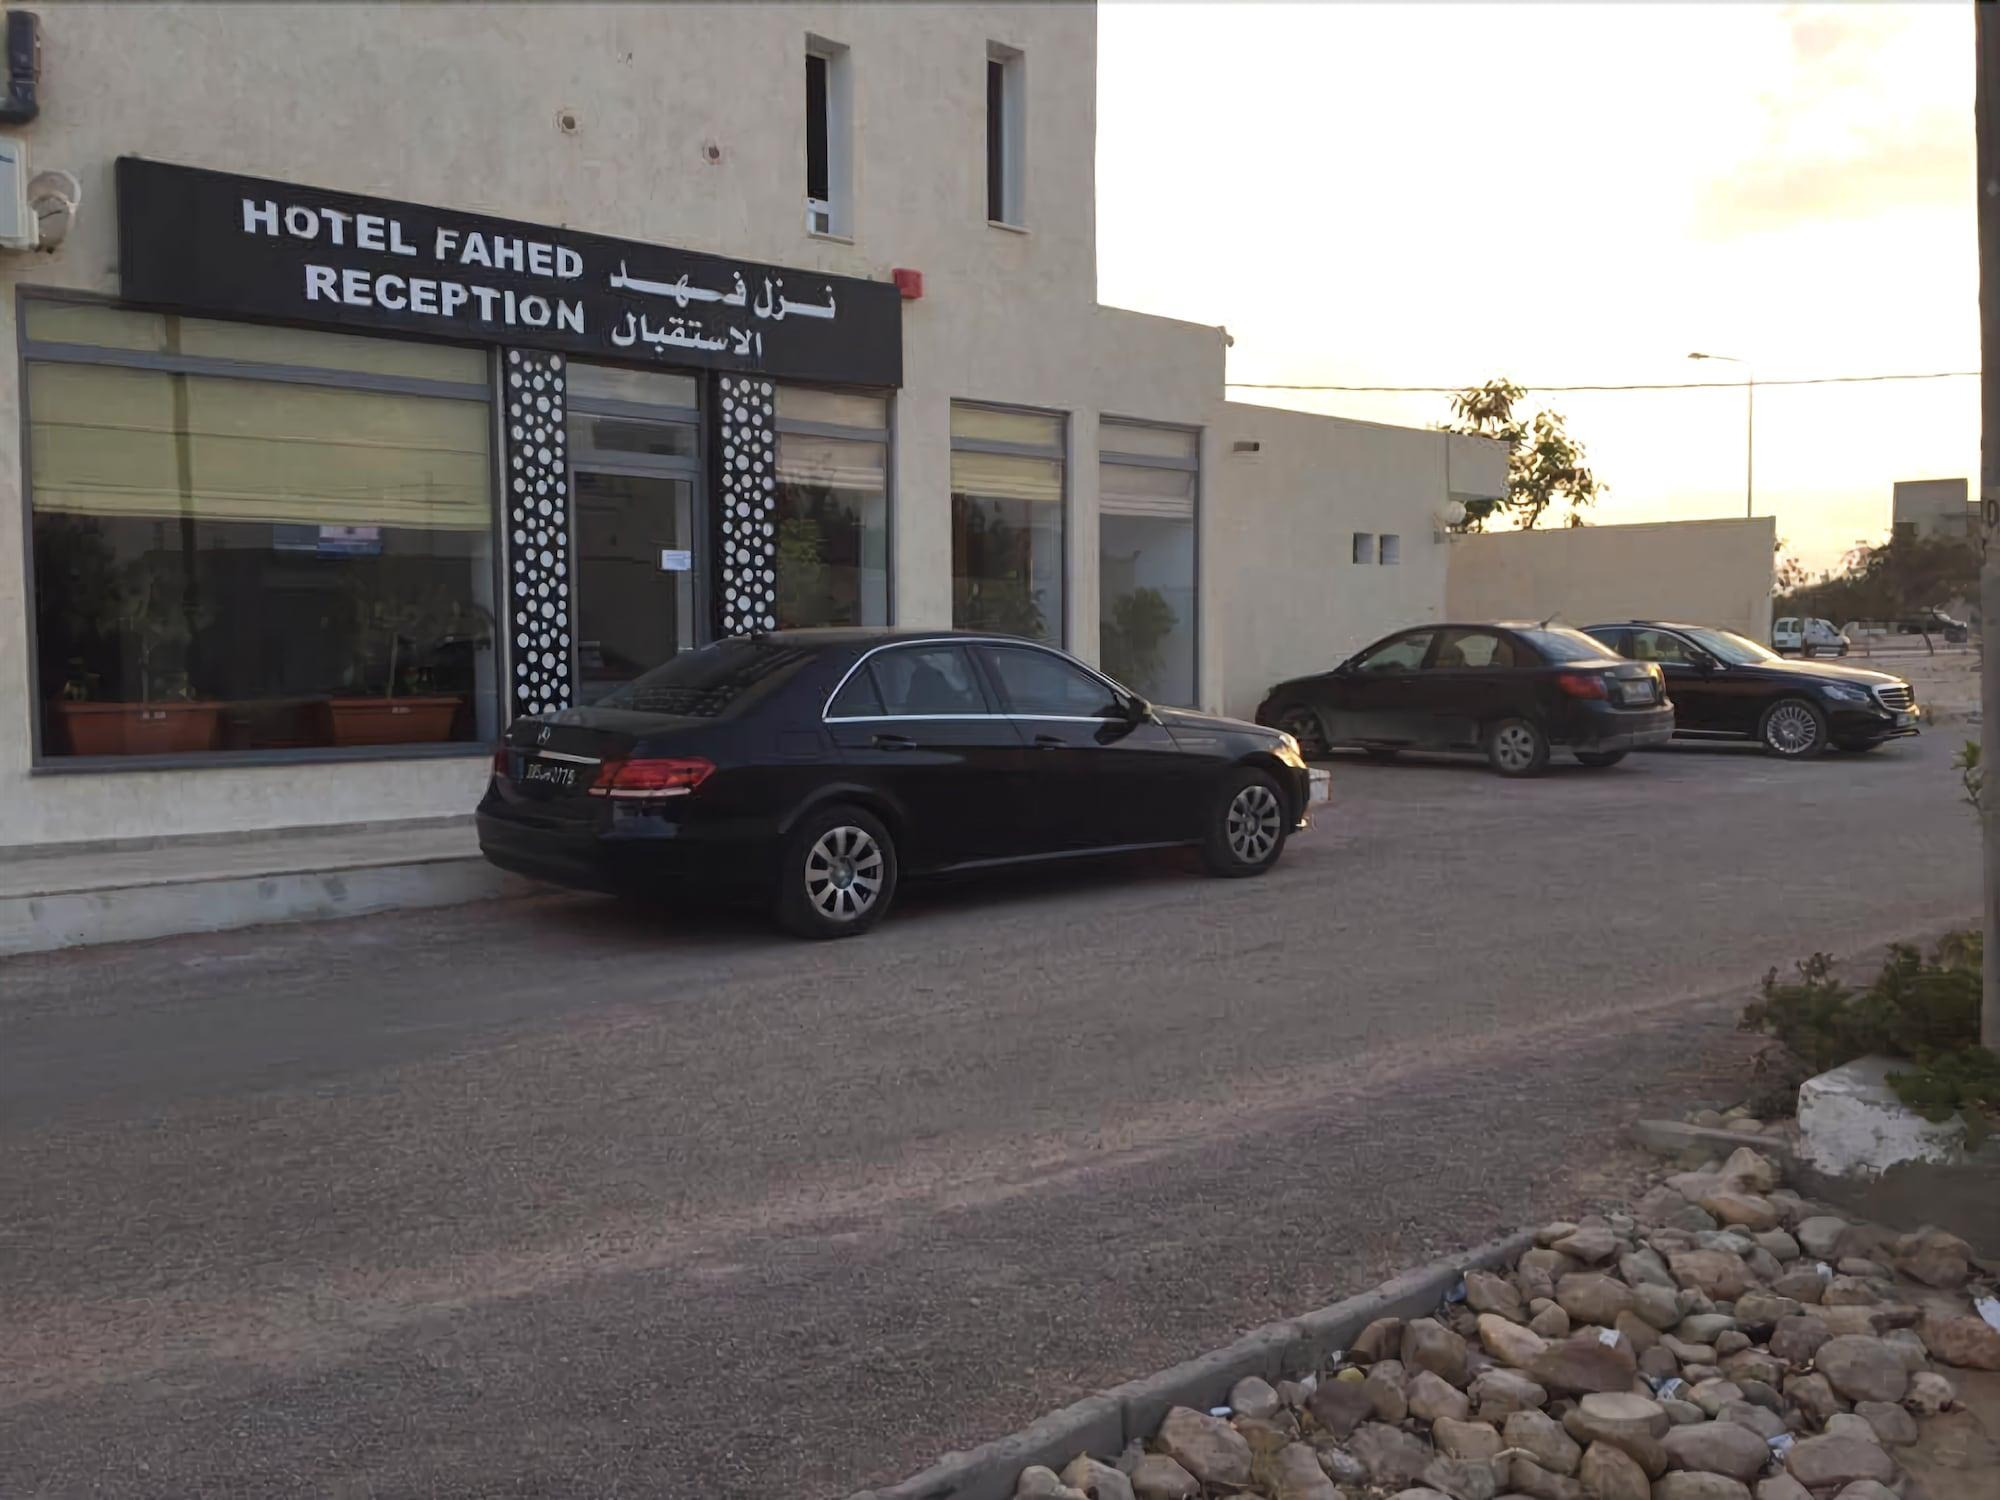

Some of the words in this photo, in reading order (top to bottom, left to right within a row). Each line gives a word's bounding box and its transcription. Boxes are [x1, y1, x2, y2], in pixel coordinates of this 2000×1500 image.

[243, 199, 417, 256] HOTEL
[435, 226, 584, 279] FAHED
[304, 263, 585, 334] RECEPTION
[610, 259, 747, 308] فهد
[753, 275, 836, 321] نزل
[611, 311, 762, 357] الاستقبال
